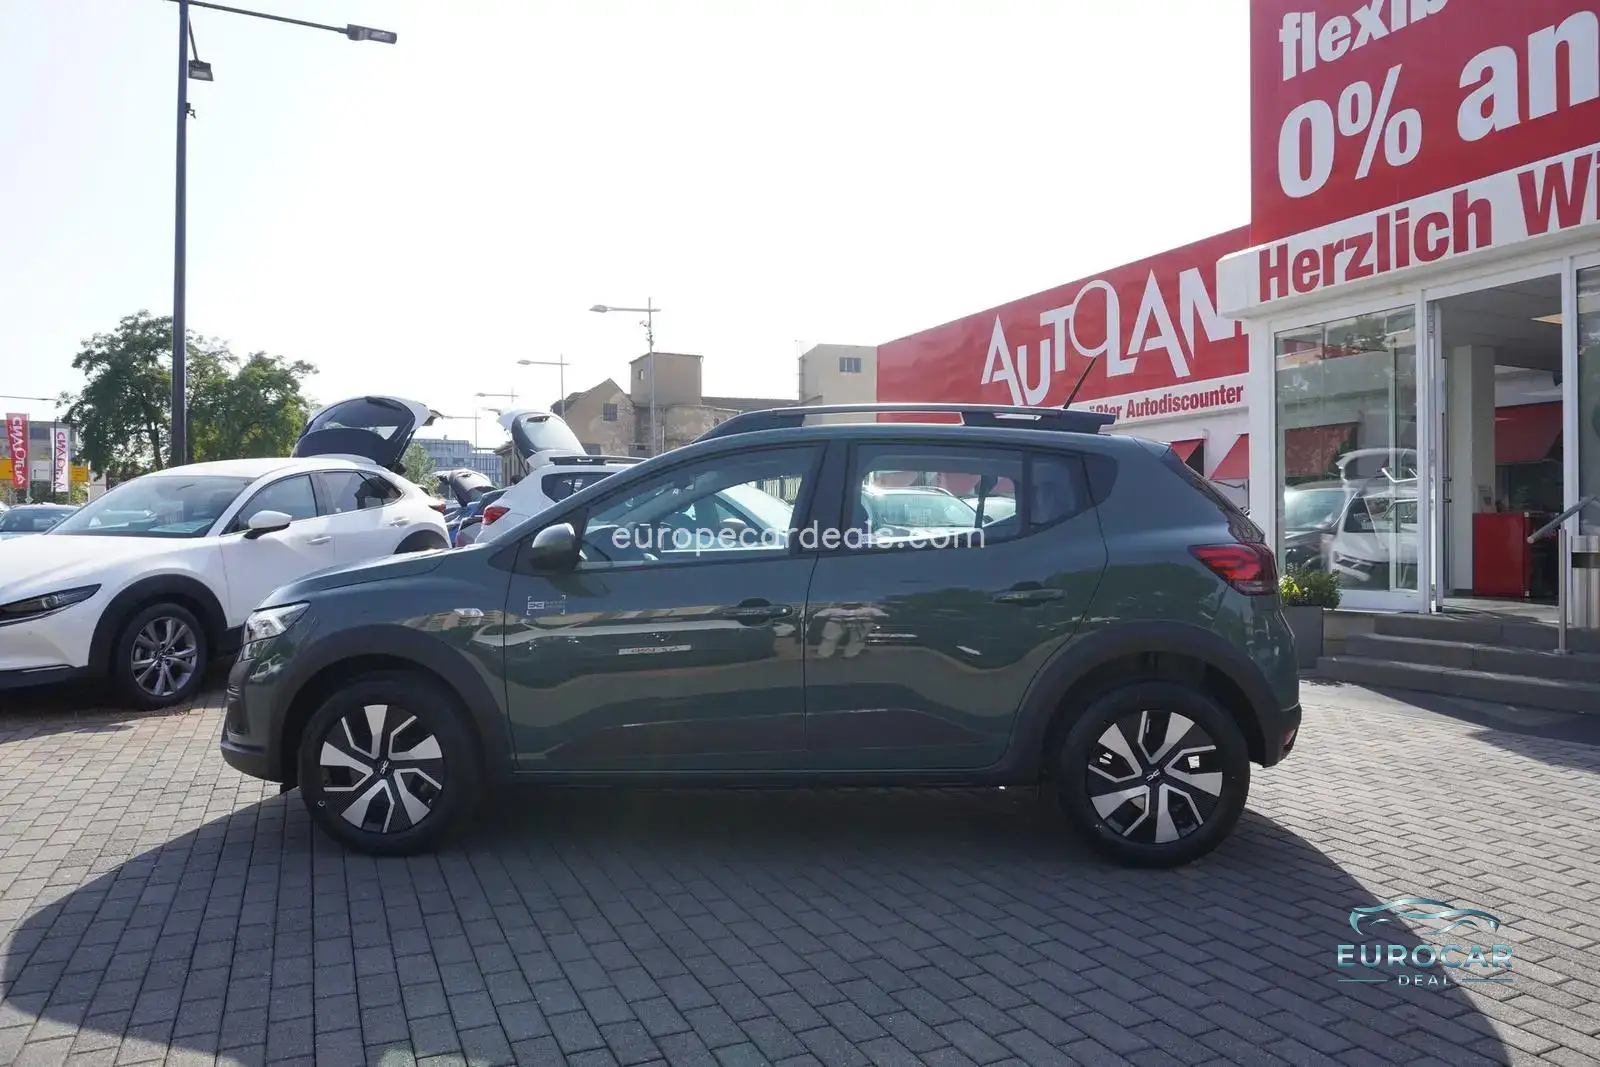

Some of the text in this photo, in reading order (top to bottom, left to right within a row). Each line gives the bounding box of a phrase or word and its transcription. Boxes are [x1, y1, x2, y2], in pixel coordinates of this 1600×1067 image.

[1278, 63, 1423, 199] 0%
[1259, 150, 1600, 303] Herzlich W
[981, 267, 1246, 406] AUTOLAN
[1126, 384, 1244, 419] Autodiscounter
